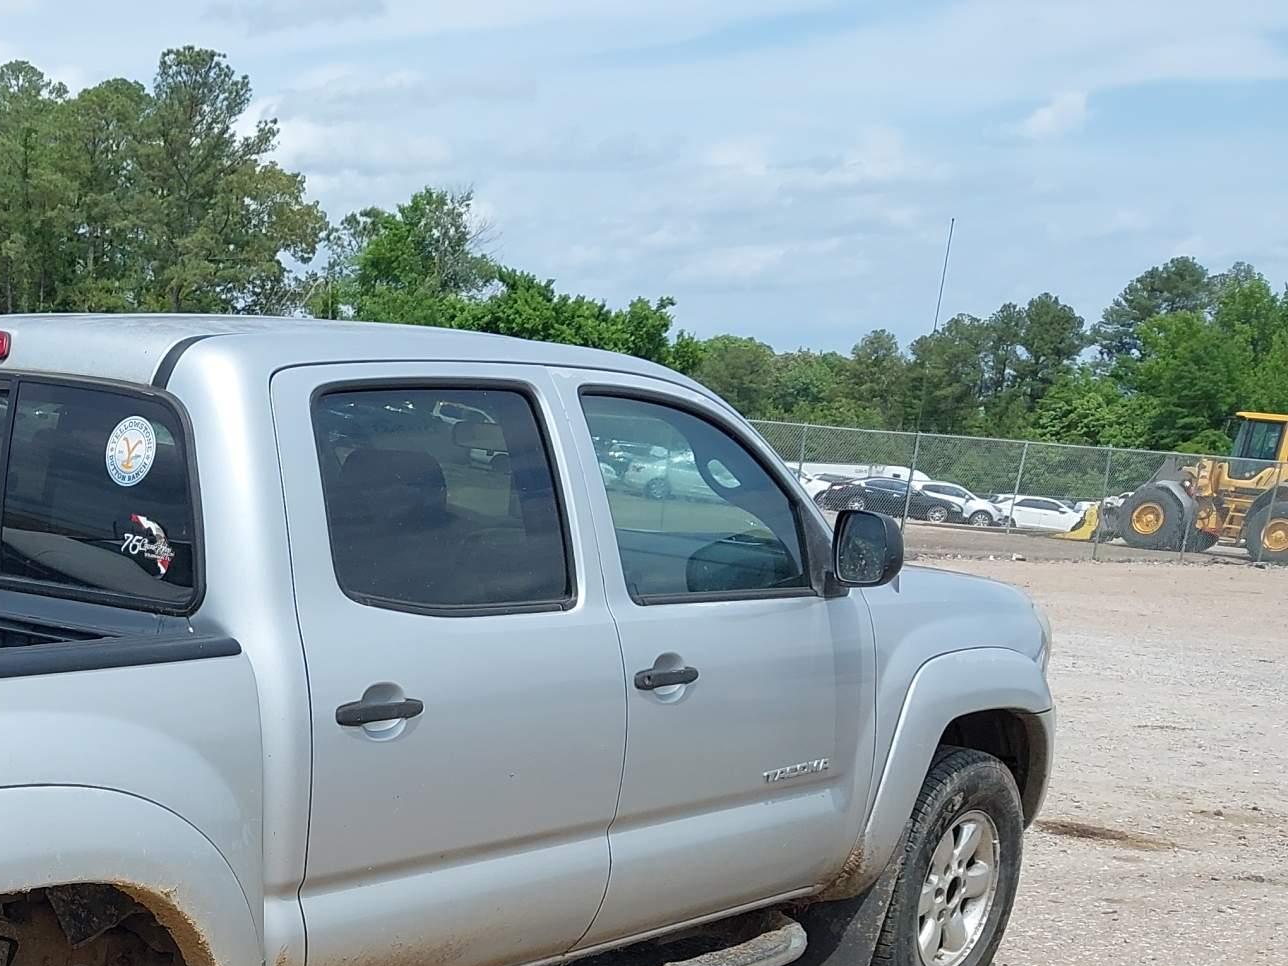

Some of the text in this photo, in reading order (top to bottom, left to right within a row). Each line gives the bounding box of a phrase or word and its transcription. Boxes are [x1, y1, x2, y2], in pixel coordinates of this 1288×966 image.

[112, 421, 152, 452] YELLOWSTONE
[109, 454, 148, 481] DUTTON RANCH
